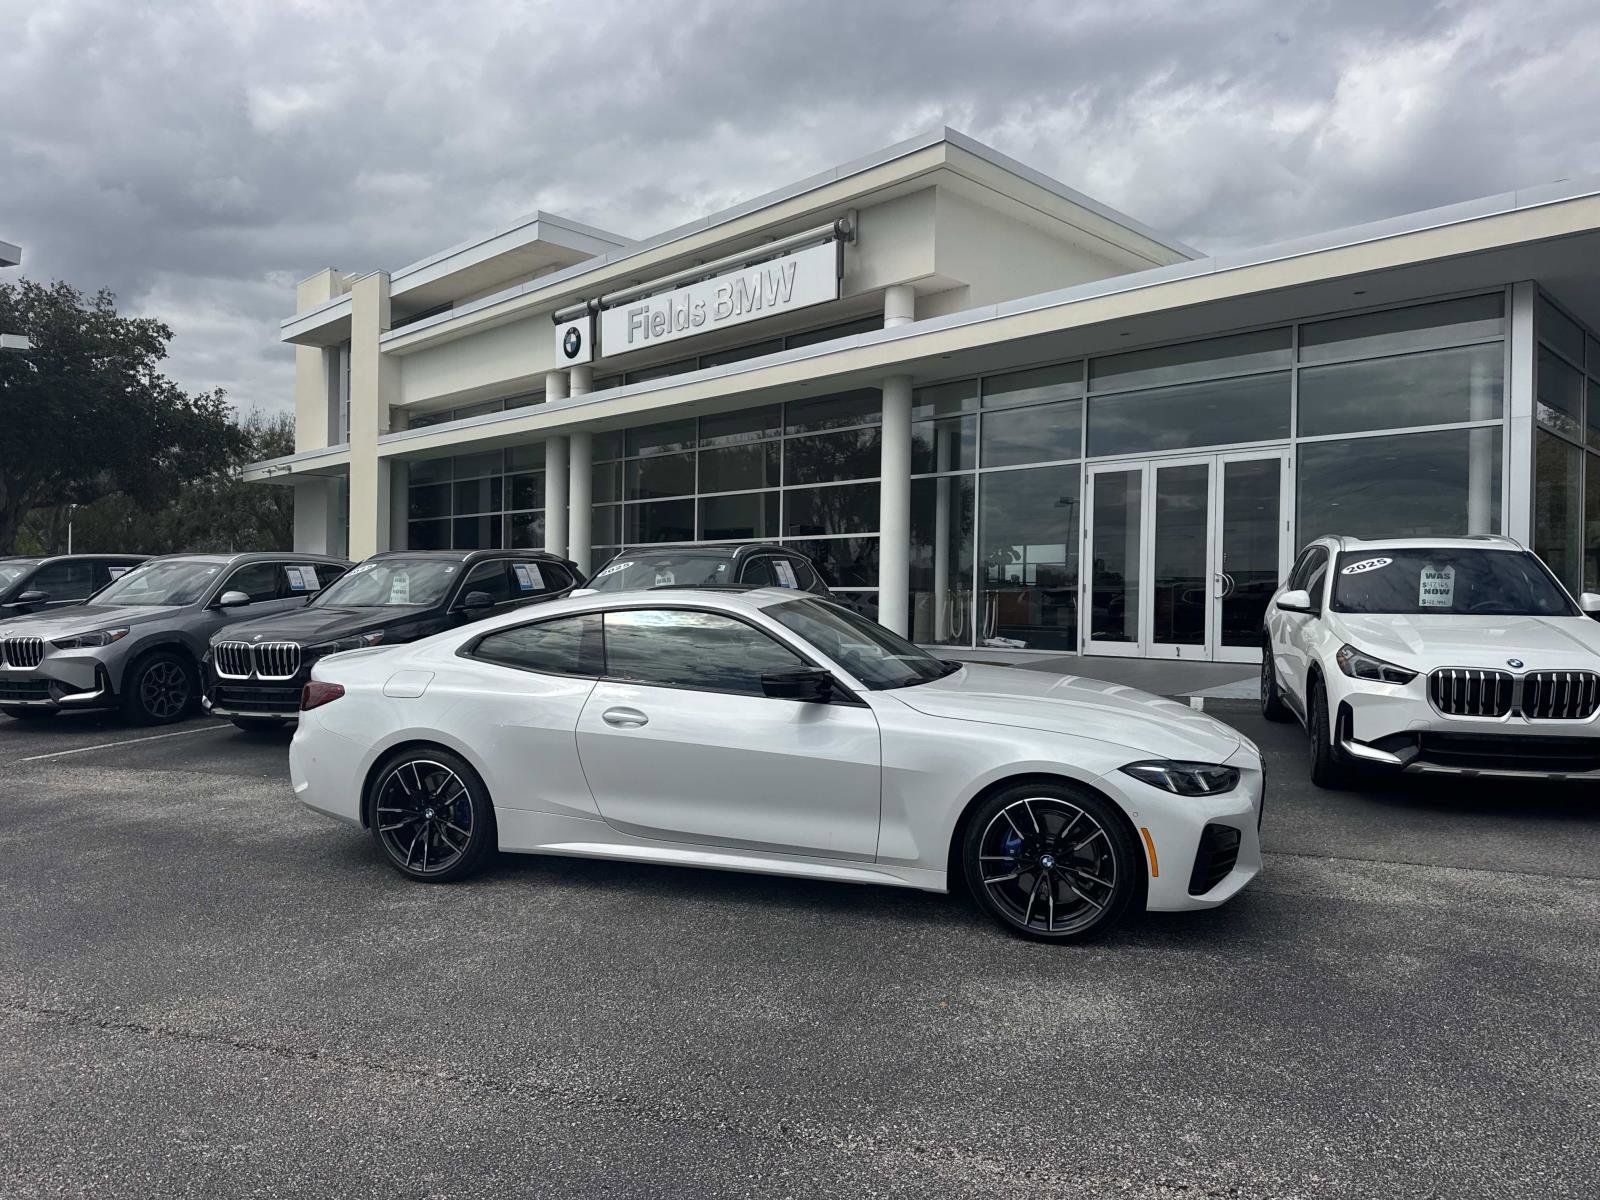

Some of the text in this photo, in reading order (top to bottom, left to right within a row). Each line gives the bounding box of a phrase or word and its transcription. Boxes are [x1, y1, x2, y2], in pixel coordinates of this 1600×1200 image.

[627, 261, 797, 345] Fields BMW
[1346, 558, 1388, 573] 2025
